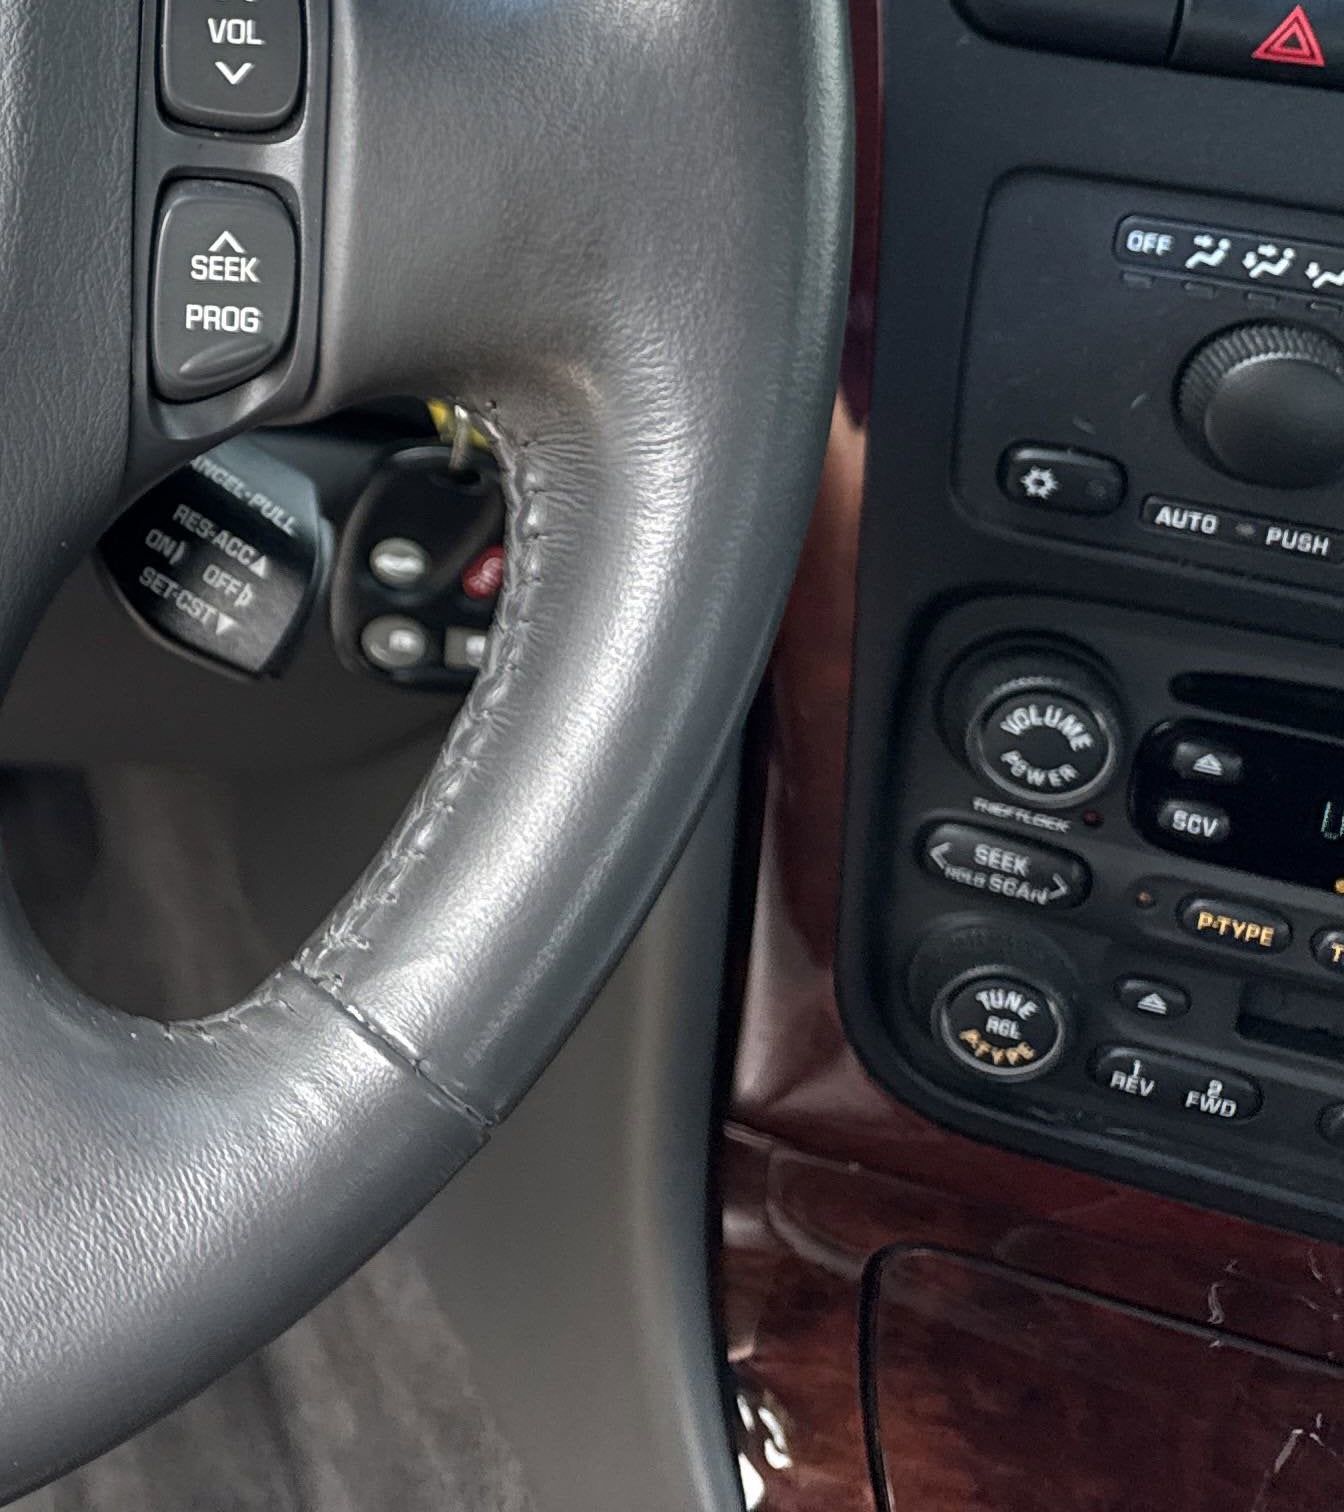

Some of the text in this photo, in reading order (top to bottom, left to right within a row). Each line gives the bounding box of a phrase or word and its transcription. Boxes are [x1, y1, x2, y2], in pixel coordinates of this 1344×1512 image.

[208, 18, 266, 45] VOL
[1126, 229, 1175, 257] OFF
[191, 255, 262, 284] SEEK
[185, 304, 263, 333] PROG
[144, 528, 178, 559] ON
[1154, 505, 1330, 557] AUTO PUSH
[202, 564, 242, 596] OFF
[999, 703, 1095, 752] VOLUME
[1000, 749, 1079, 787] POWER
[1171, 808, 1220, 838] SCV
[973, 843, 1031, 877] SEEK
[988, 873, 1049, 906] SCAN
[975, 988, 1040, 1021] TUNE
[1109, 1070, 1156, 1097] REV
[1184, 1090, 1238, 1118] FWD
